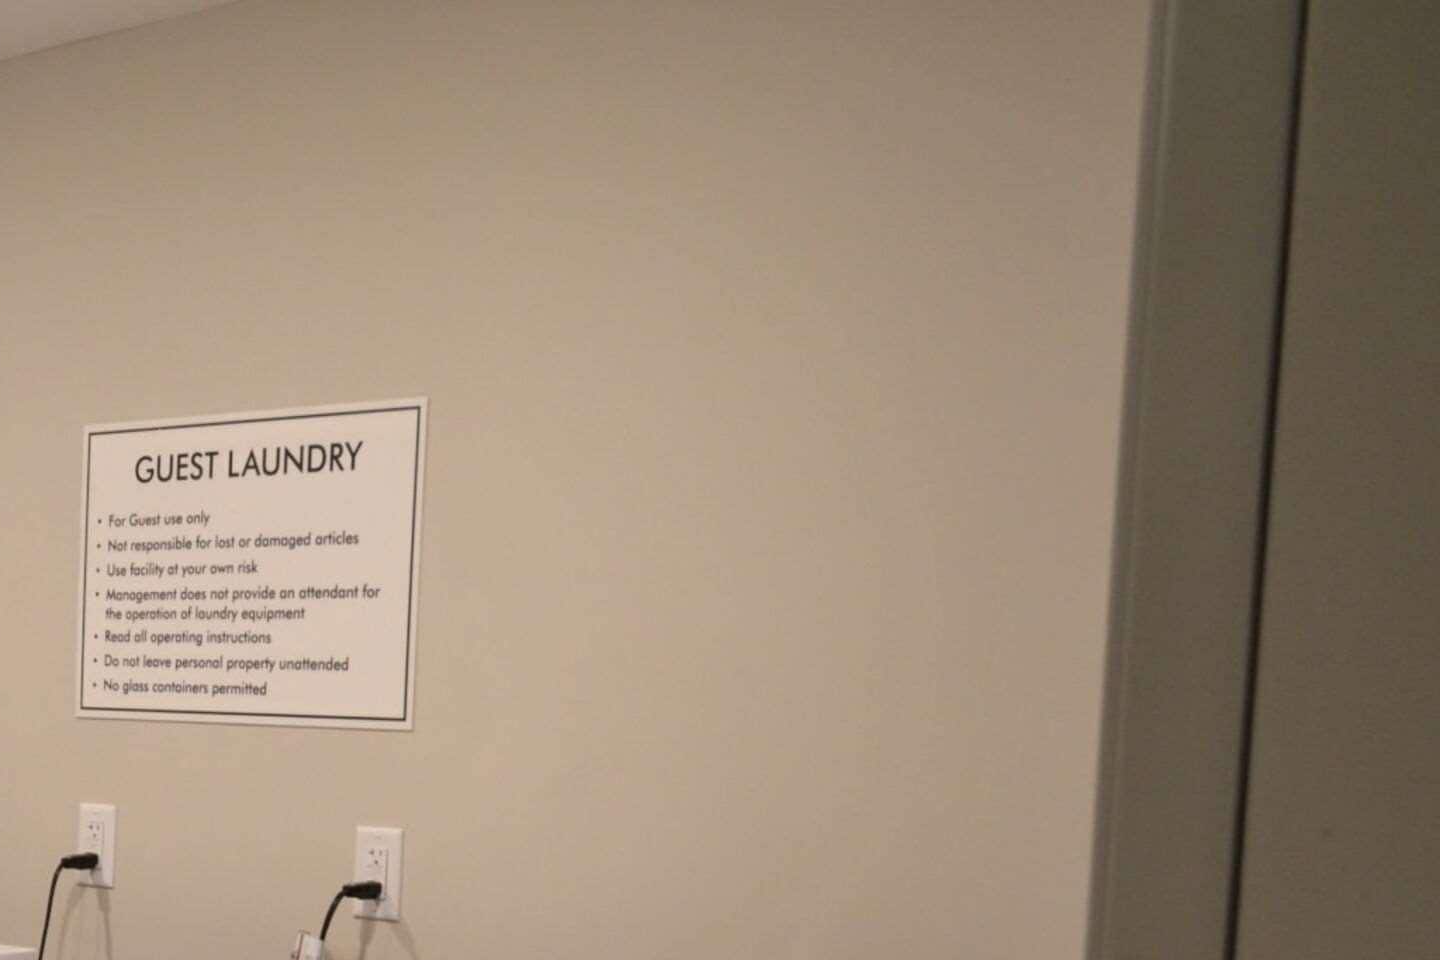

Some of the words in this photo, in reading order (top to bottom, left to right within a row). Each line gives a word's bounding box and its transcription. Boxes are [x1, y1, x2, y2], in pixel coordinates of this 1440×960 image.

[134, 450, 219, 484] GUEST
[228, 441, 363, 479] LAUNDRY
[109, 514, 126, 527] For
[129, 513, 160, 527] Guest
[164, 514, 182, 525] use
[186, 509, 210, 527] only
[108, 540, 127, 551] Not
[131, 537, 192, 553] responsible
[196, 535, 211, 548] for
[215, 534, 235, 548] lost
[239, 537, 251, 547] or
[254, 532, 311, 549] damaged
[315, 530, 359, 546] articles
[107, 563, 126, 576] Use
[130, 562, 164, 577] facility
[167, 563, 178, 575] at
[182, 564, 206, 577] your
[210, 564, 234, 574] own
[237, 560, 257, 574] risk
[106, 589, 177, 604] Management
[180, 587, 206, 600] does
[211, 588, 229, 599] not
[232, 585, 275, 601] provide
[279, 588, 295, 599] an
[298, 584, 358, 599] attendant
[362, 583, 381, 598] for
[105, 607, 122, 620] the
[126, 608, 177, 622] operation
[180, 606, 193, 620] of
[195, 606, 238, 622] laundry
[241, 606, 305, 622] equipment
[104, 630, 130, 643] Read
[134, 629, 147, 643] all
[150, 631, 203, 646] operating
[206, 630, 272, 644] instructions
[104, 654, 119, 667] Do
[122, 656, 140, 667] not
[143, 655, 171, 668] leave
[175, 655, 223, 671] personal
[226, 657, 276, 672] property
[279, 656, 349, 671] unattended
[103, 679, 119, 692] No
[122, 678, 149, 694] glass
[152, 679, 209, 694] containers
[212, 681, 267, 697] permitted
